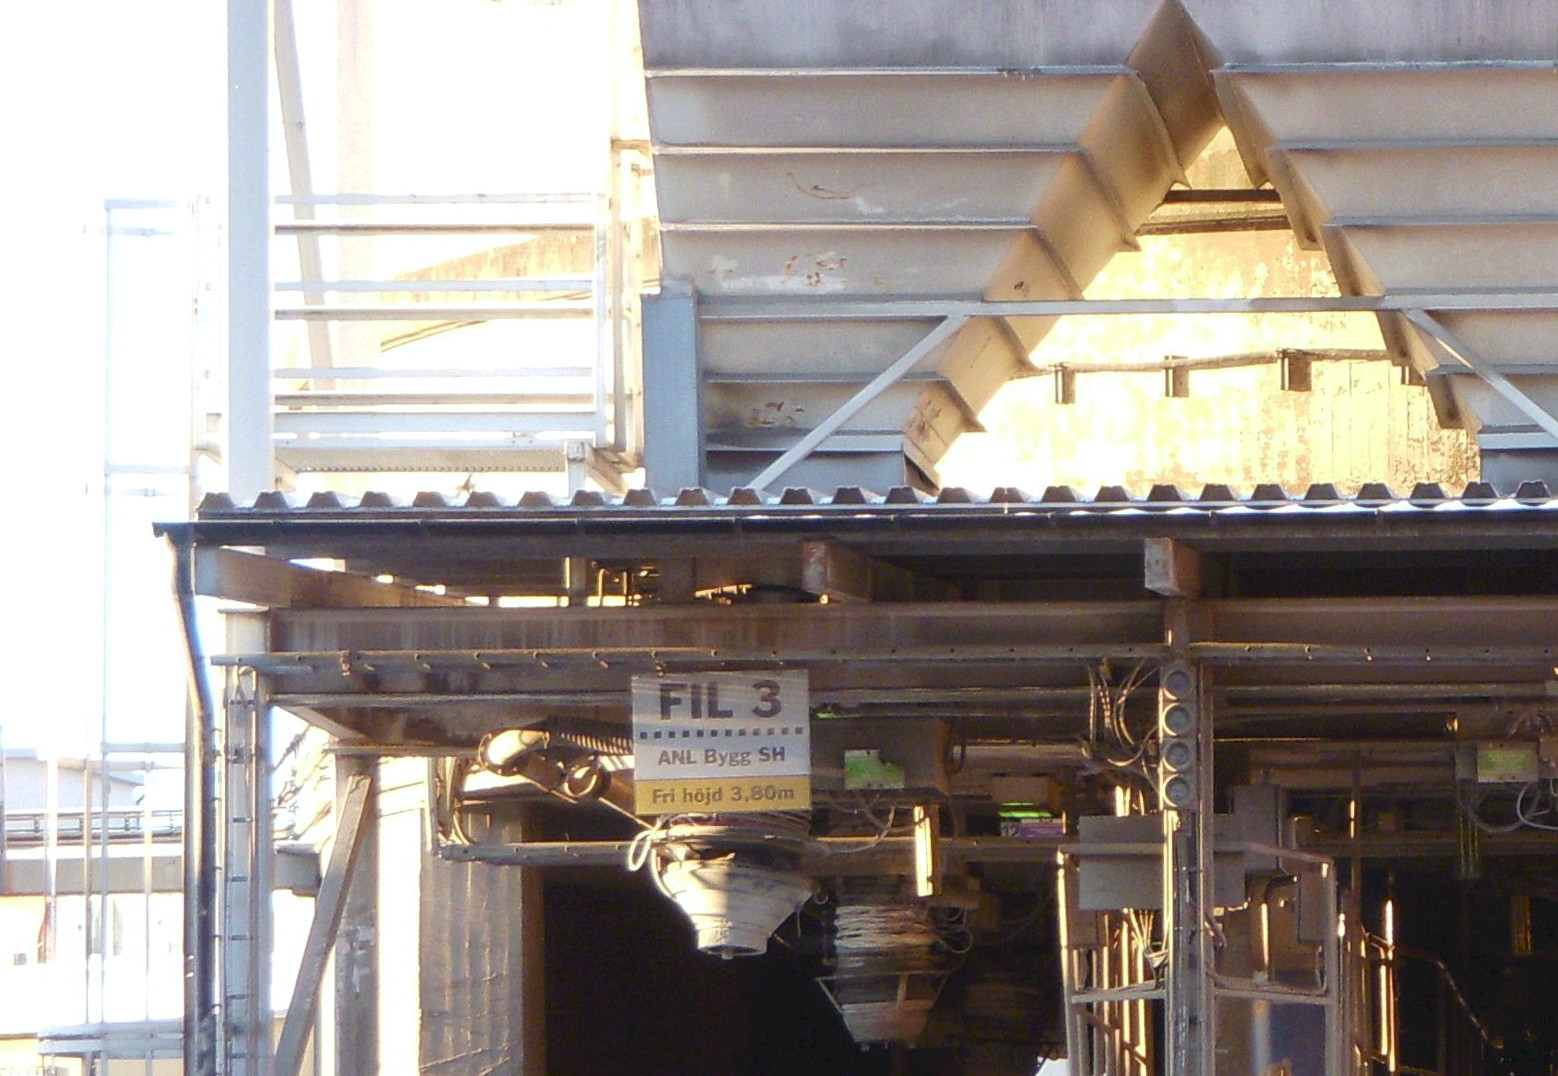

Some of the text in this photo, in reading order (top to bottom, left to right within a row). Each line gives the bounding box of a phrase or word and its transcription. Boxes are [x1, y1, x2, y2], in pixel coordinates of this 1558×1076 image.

[660, 680, 782, 720] FIL 3
[658, 747, 785, 766] ANL Bygg SH
[652, 785, 794, 805] Fri höjd 3,80m
